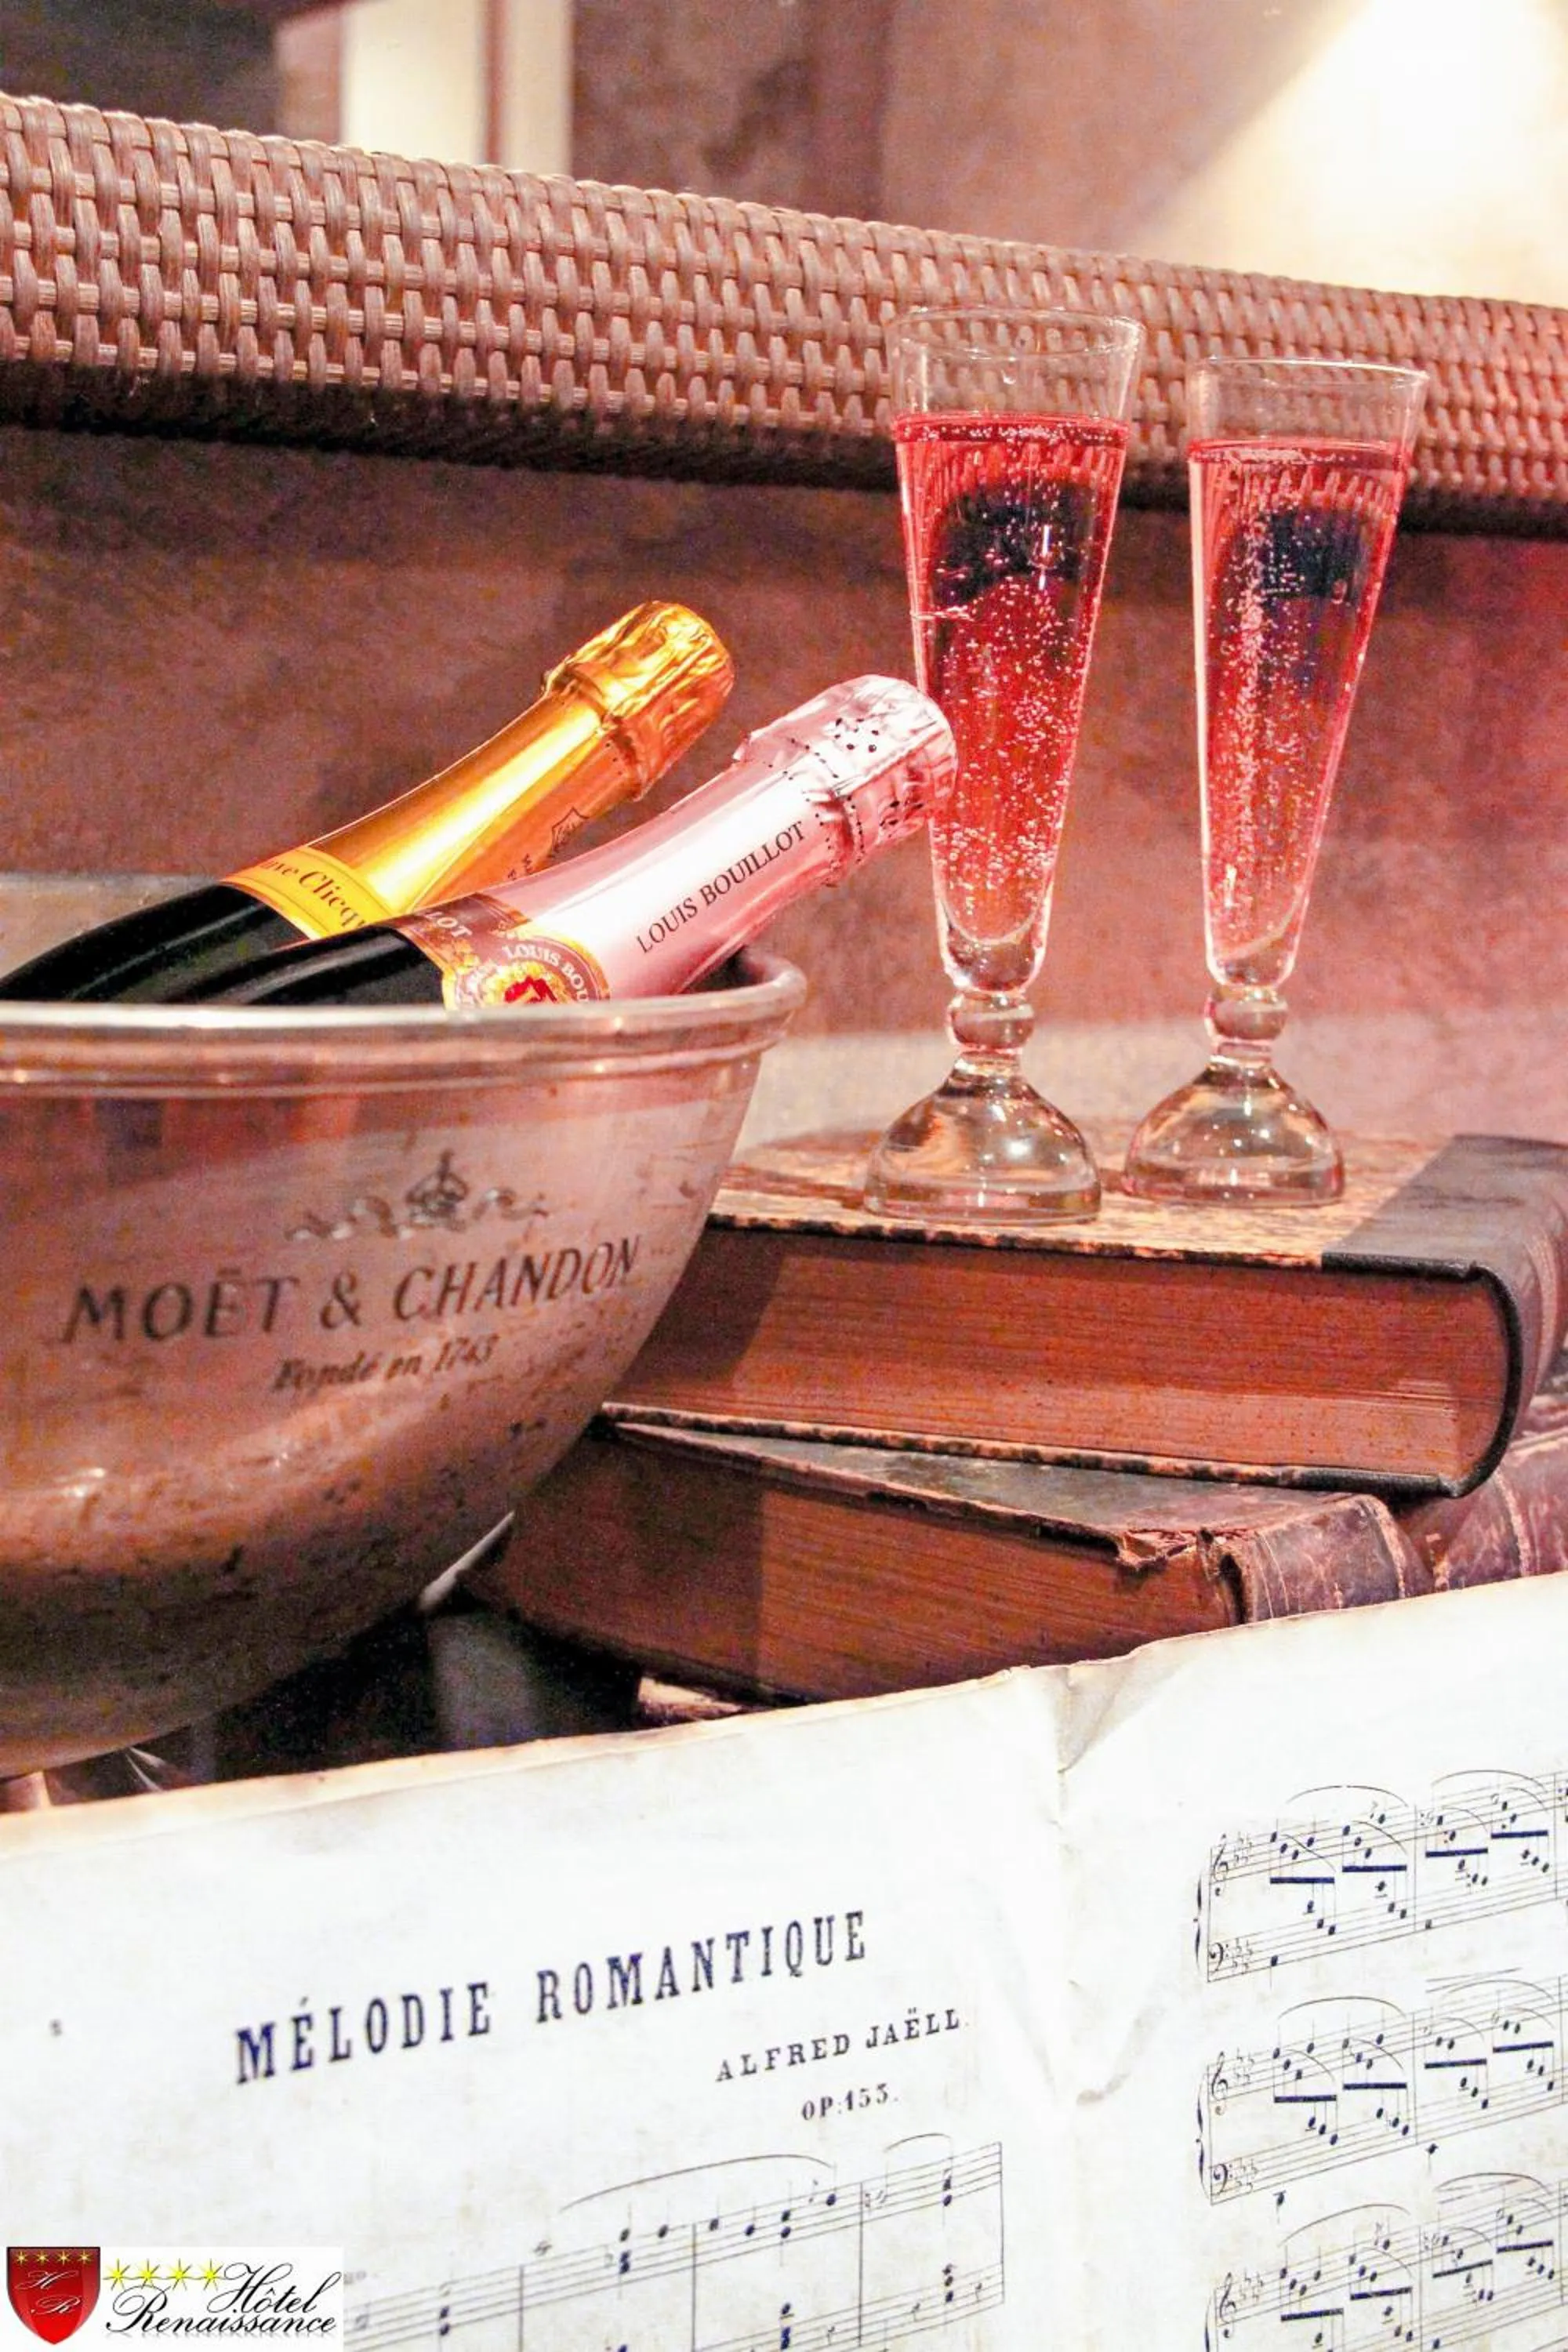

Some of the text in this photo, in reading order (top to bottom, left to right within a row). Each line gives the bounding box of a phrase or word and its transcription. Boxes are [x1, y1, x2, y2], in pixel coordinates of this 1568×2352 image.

[423, 911, 474, 938] LOT
[637, 821, 804, 953] LOUIS BOUILLOT
[501, 943, 590, 1002] LOUIS BOU
[60, 1236, 640, 1344] MOËT & CHANDON
[236, 1911, 866, 2085] MÉLODIE ROMANTIQUE
[716, 2034, 851, 2082] ALFRED
